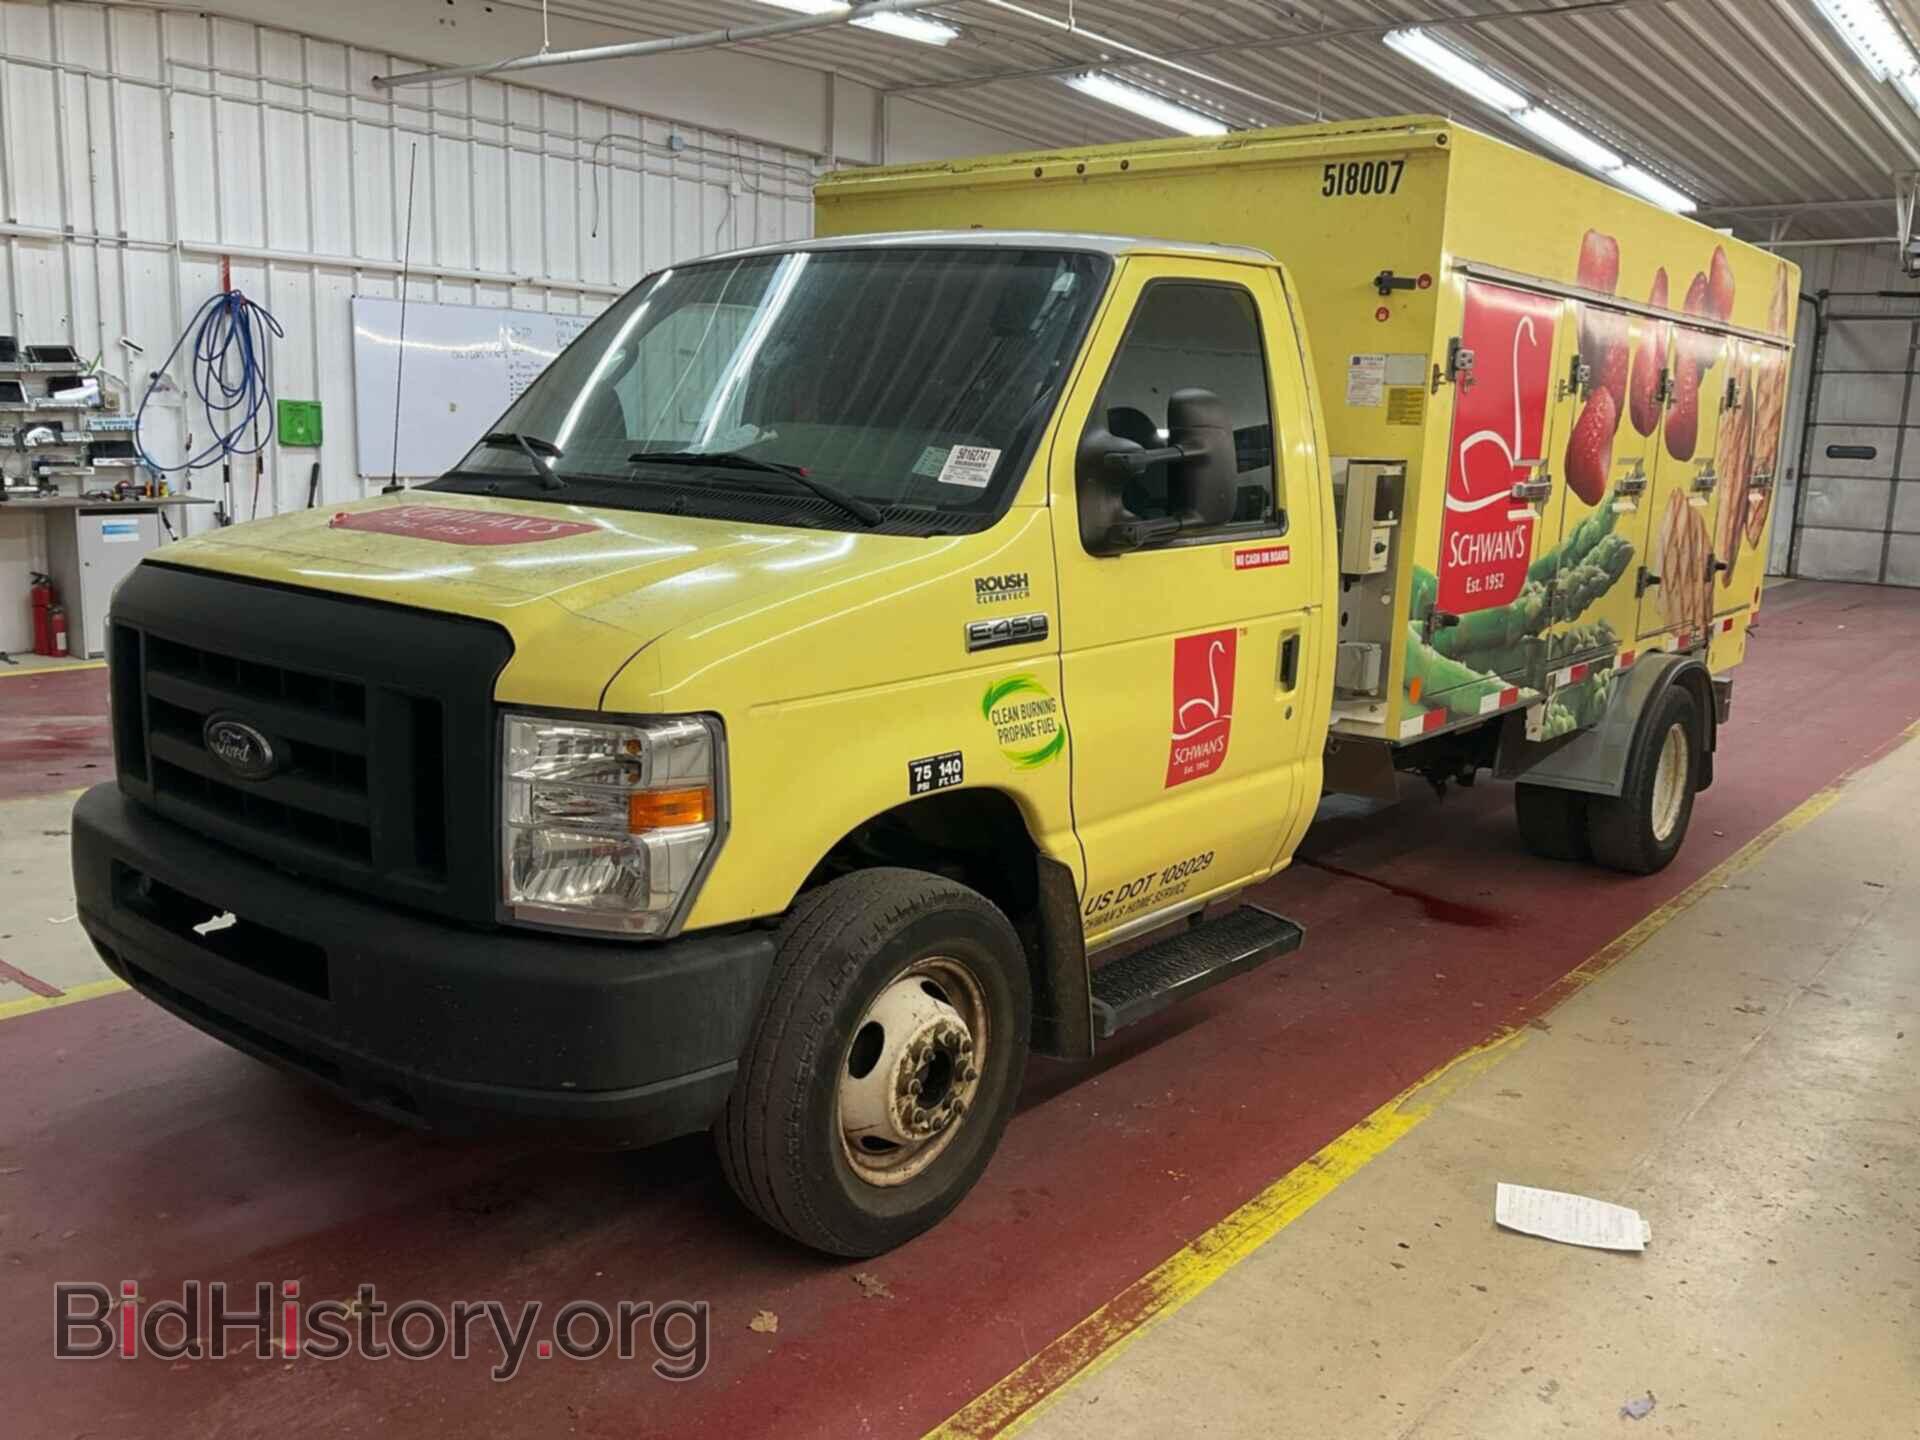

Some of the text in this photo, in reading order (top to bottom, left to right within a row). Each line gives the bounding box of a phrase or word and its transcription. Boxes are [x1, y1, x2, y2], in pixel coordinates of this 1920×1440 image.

[1322, 160, 1404, 197] 518007
[1448, 524, 1526, 568] SCHWAN'S
[975, 573, 1029, 592] ROUSH
[1466, 572, 1504, 594] Est. 1952
[977, 591, 1030, 604] CLEANTECH
[992, 697, 1056, 727] CLEAN BURNING
[998, 716, 1057, 745] PROPANE FUEL
[209, 729, 251, 763] Ford
[1173, 735, 1225, 766] SCHWAN'S
[914, 764, 932, 782] 75
[939, 759, 961, 777] 140
[917, 781, 930, 793] PSI
[1085, 851, 1214, 916] US DOT 108029
